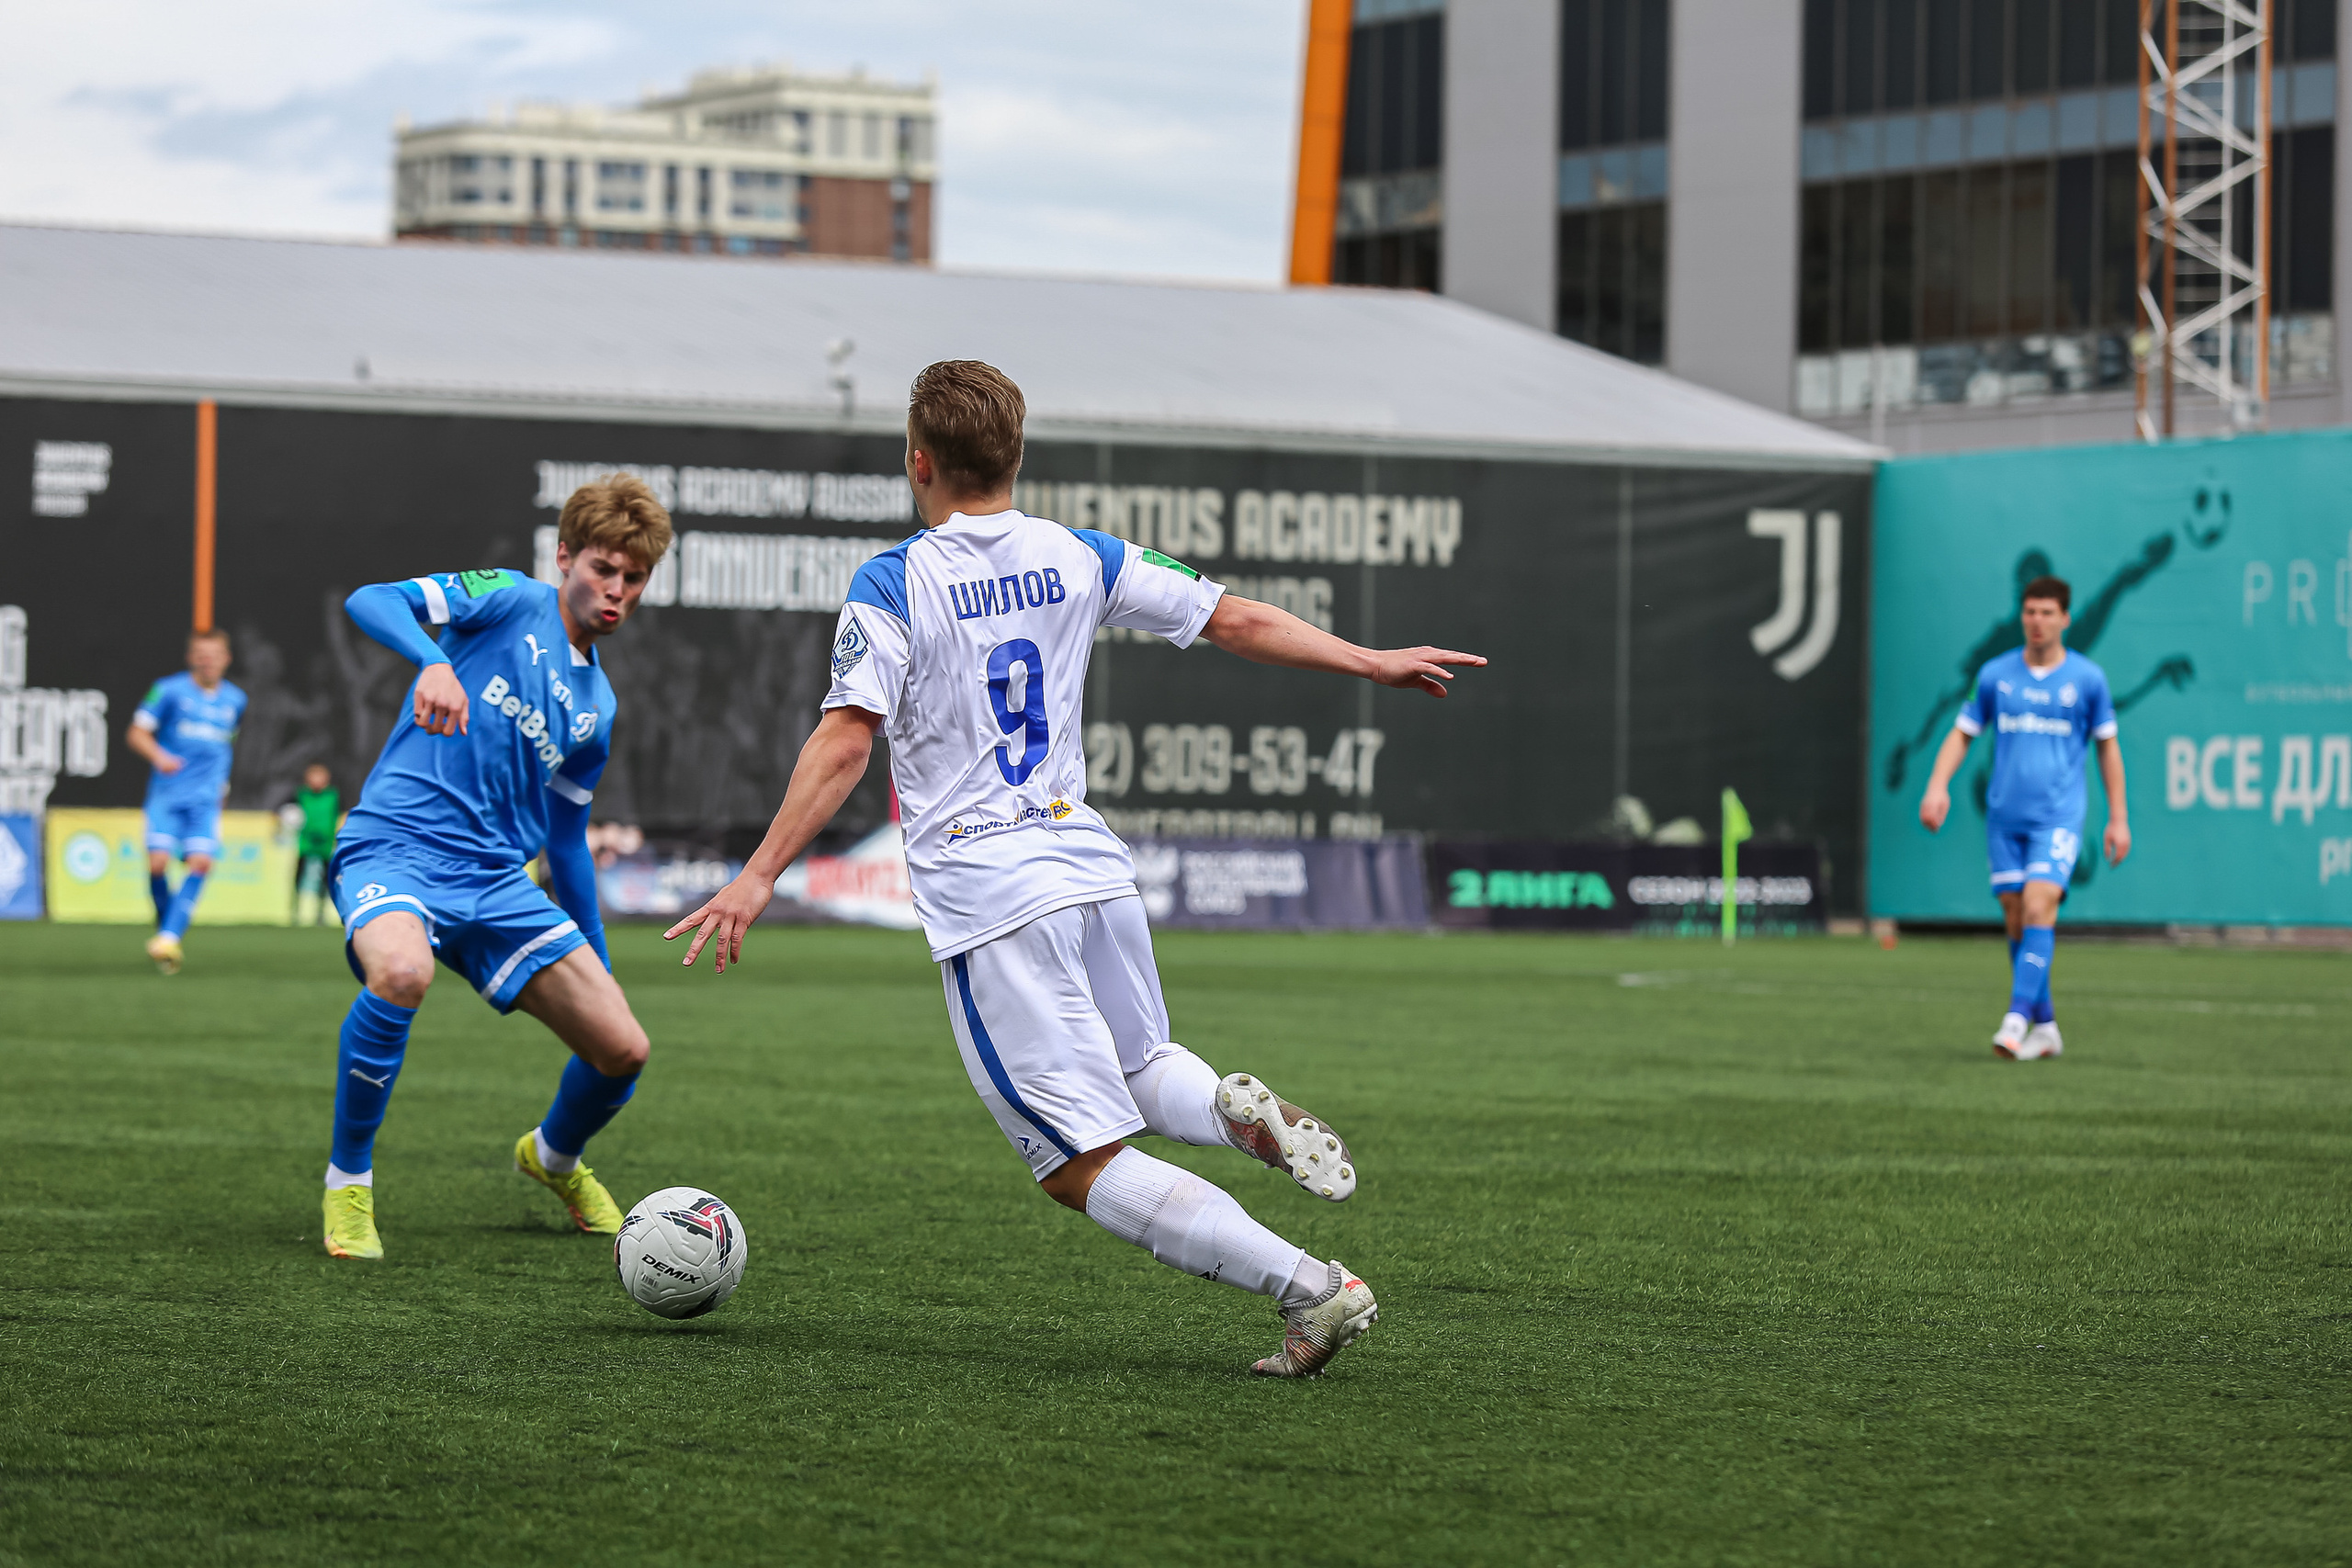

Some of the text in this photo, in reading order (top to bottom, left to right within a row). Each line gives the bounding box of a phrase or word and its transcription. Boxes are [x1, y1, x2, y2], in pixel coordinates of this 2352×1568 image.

[1234, 488, 1463, 567] ACADEMY
[949, 568, 1067, 620] ШИЛОВ
[987, 638, 1049, 786] 9
[1141, 723, 1385, 796] 309-53-47
[2166, 735, 2264, 811] ВСЕ
[641, 1254, 701, 1284] DEMIX
